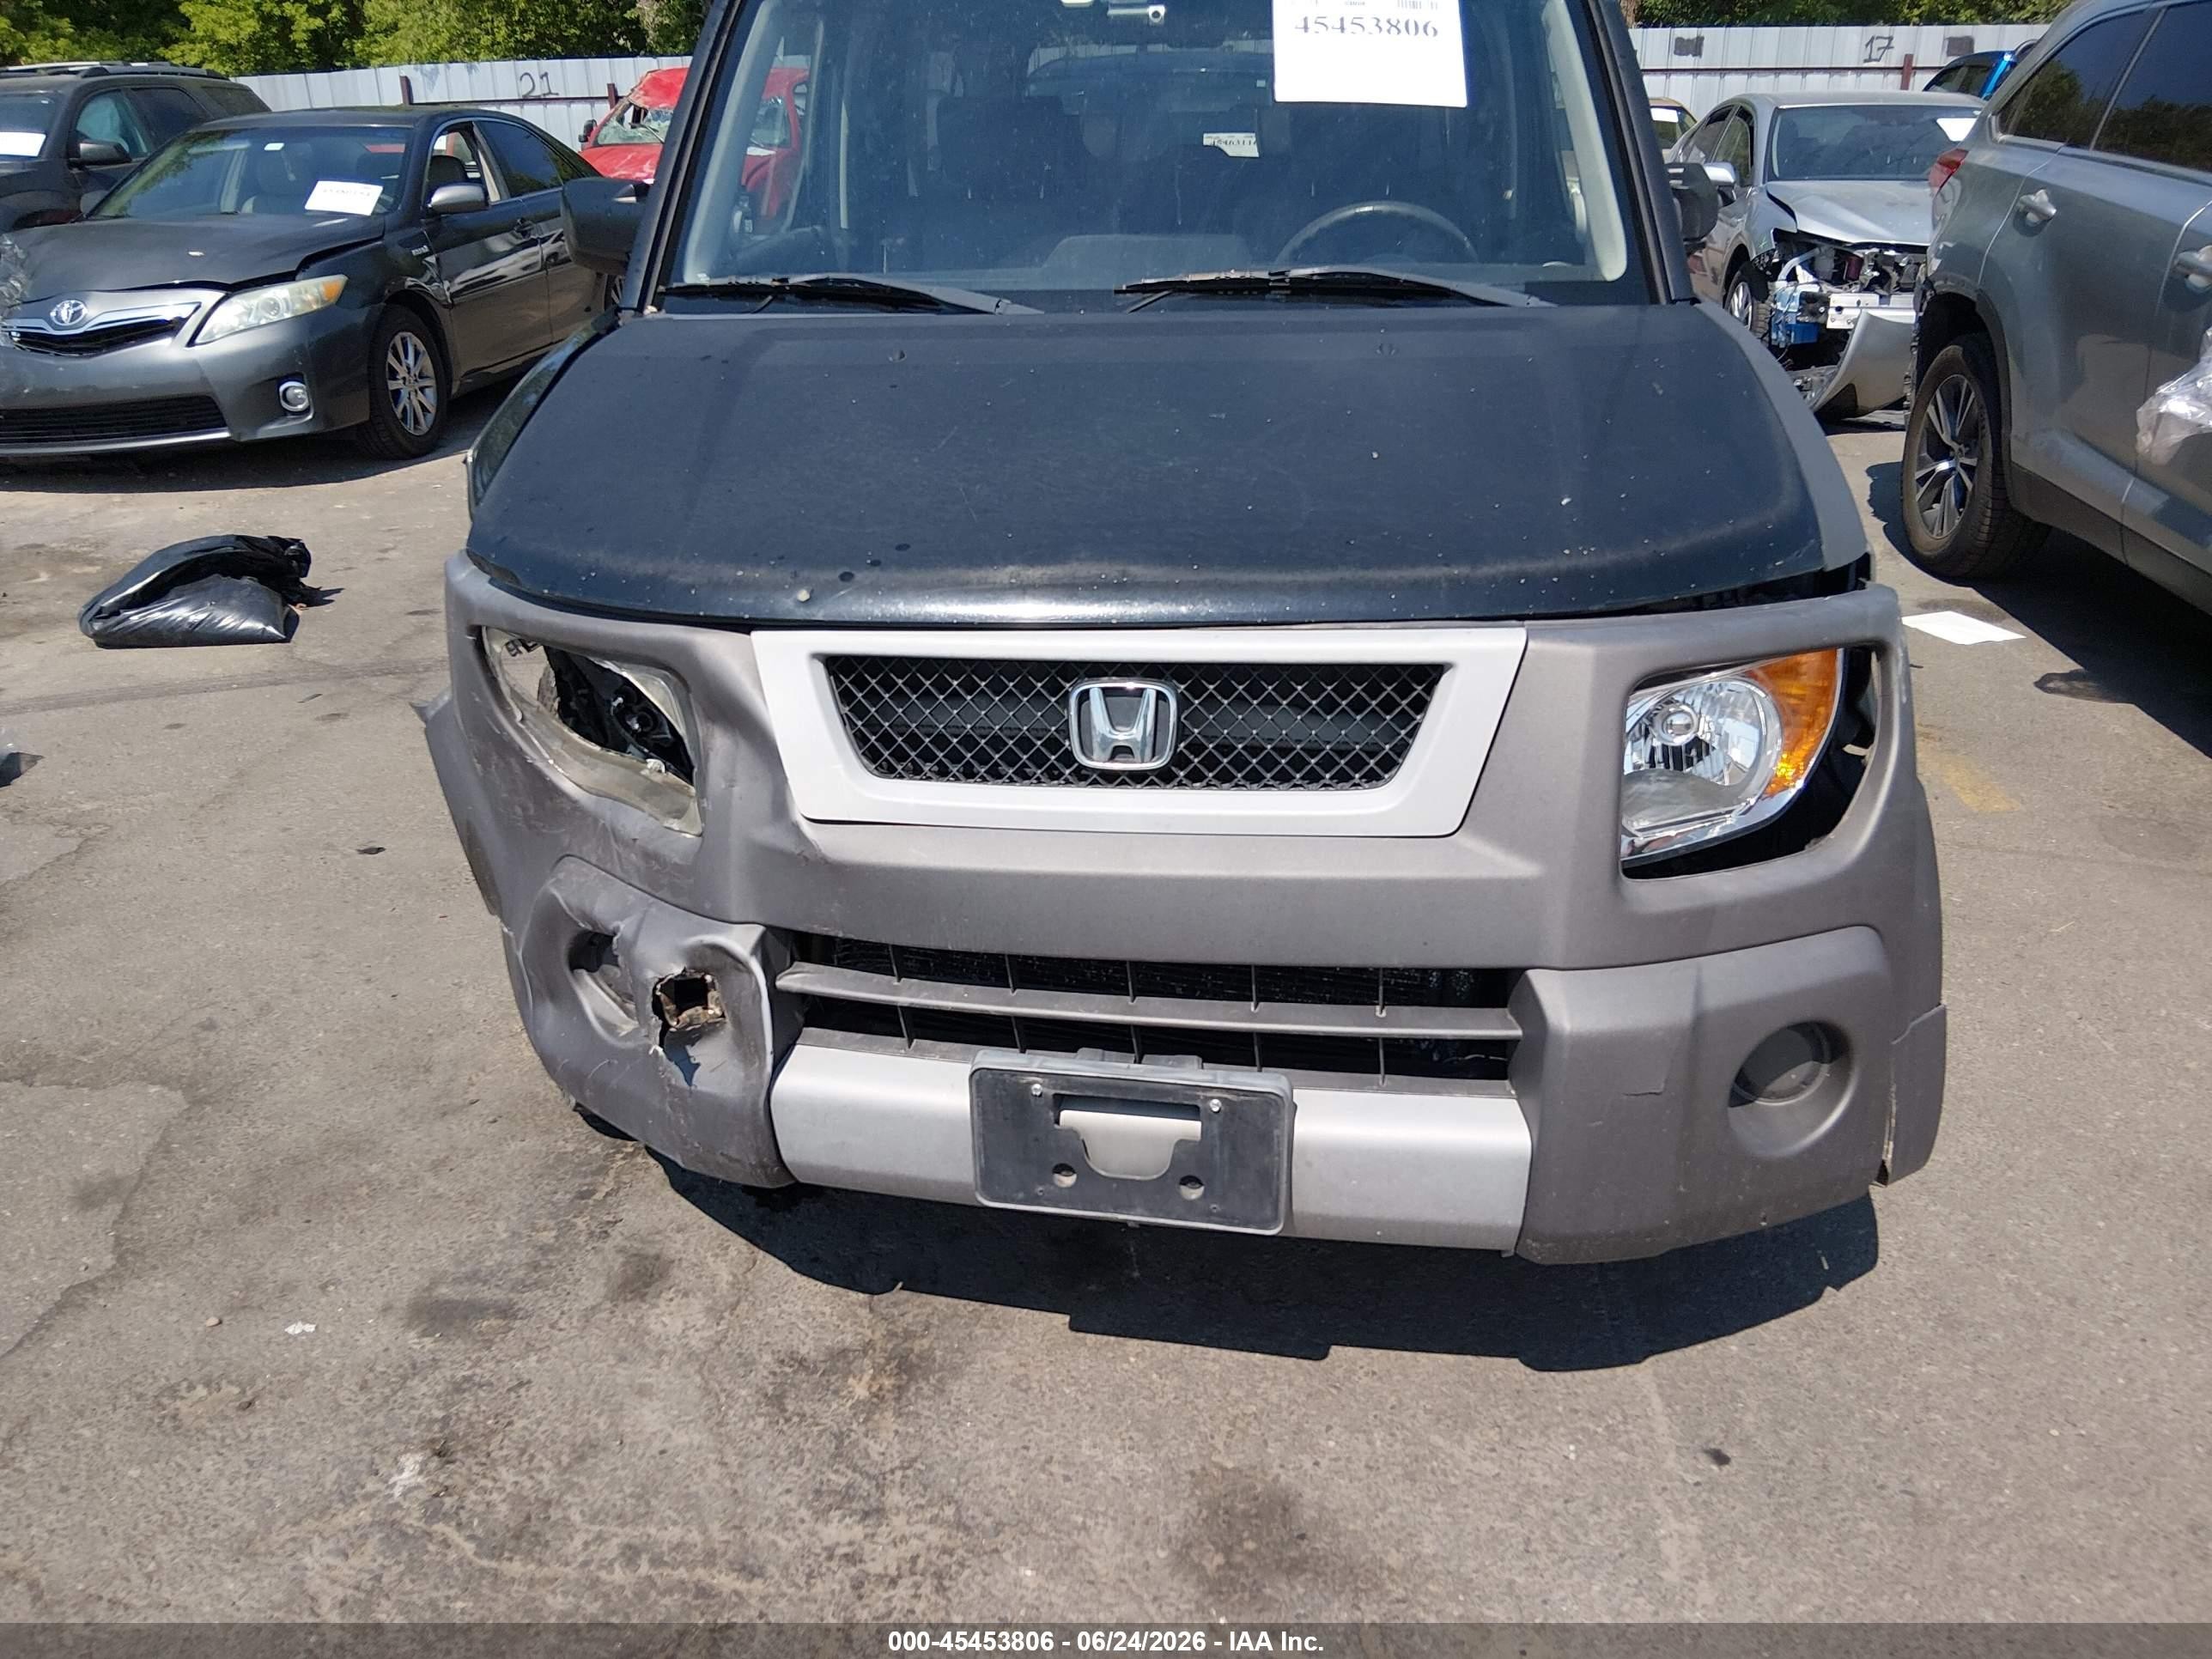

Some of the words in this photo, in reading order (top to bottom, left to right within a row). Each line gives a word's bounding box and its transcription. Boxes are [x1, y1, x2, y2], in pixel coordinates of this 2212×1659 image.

[1294, 15, 1438, 37] 45453806
[1863, 35, 1894, 63] 17
[520, 71, 559, 99] 21
